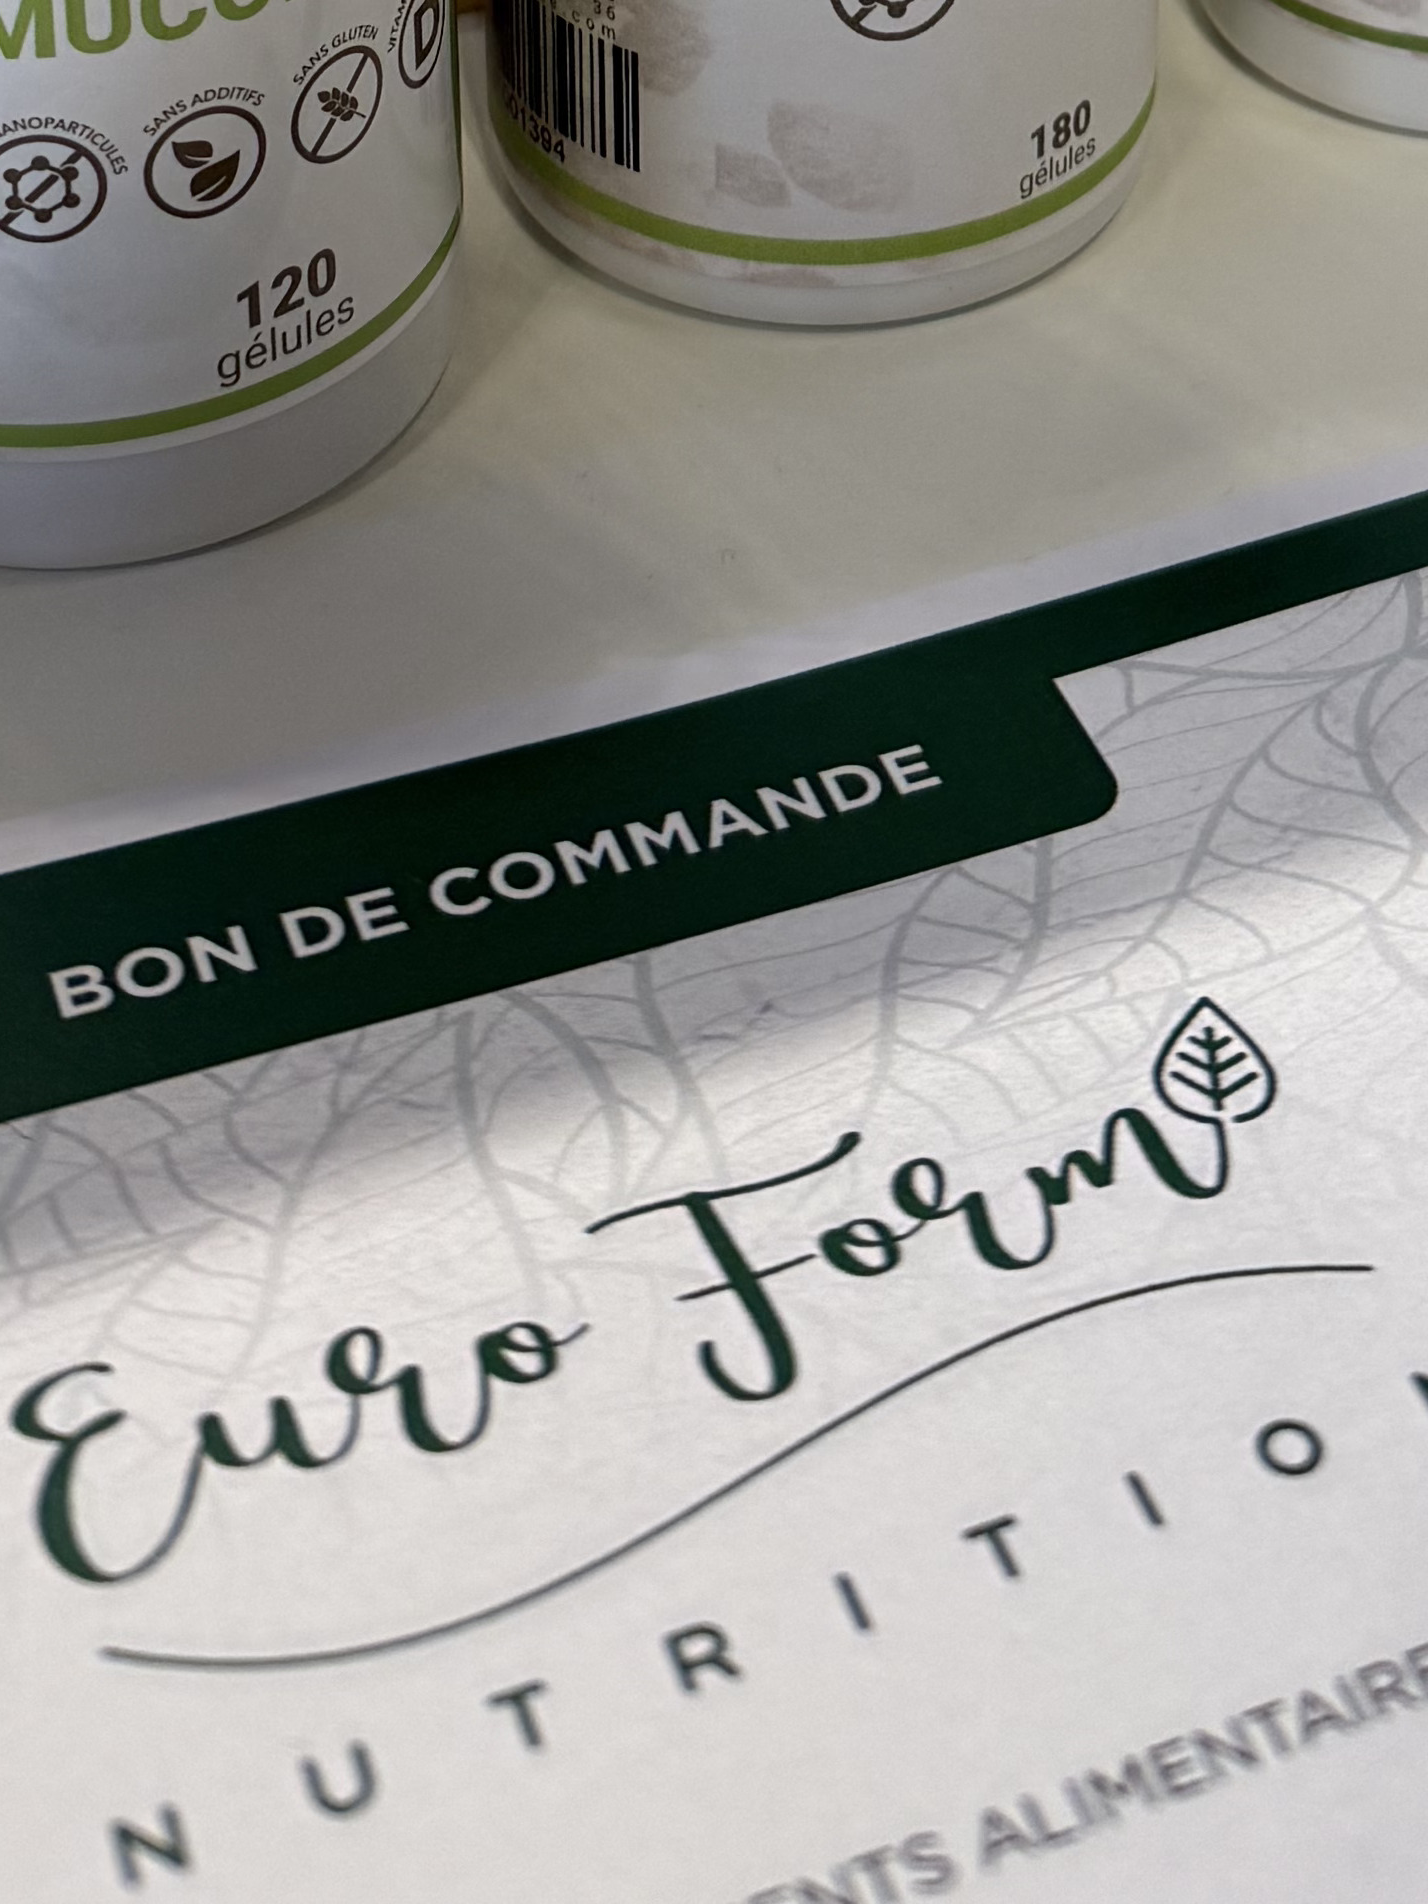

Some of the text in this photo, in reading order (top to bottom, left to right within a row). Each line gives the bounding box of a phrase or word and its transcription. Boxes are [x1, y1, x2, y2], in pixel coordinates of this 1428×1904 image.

[292, 24, 380, 87] SANS GLUTEN
[142, 87, 266, 138] SANS ADDITIFS
[1031, 100, 1095, 161] 180
[1020, 134, 1099, 200] gélules
[237, 248, 336, 332] 120
[213, 291, 358, 391] gélules
[49, 745, 949, 1018] BON DE COMMANDE
[9, 1105, 1236, 1590] Euro Form
